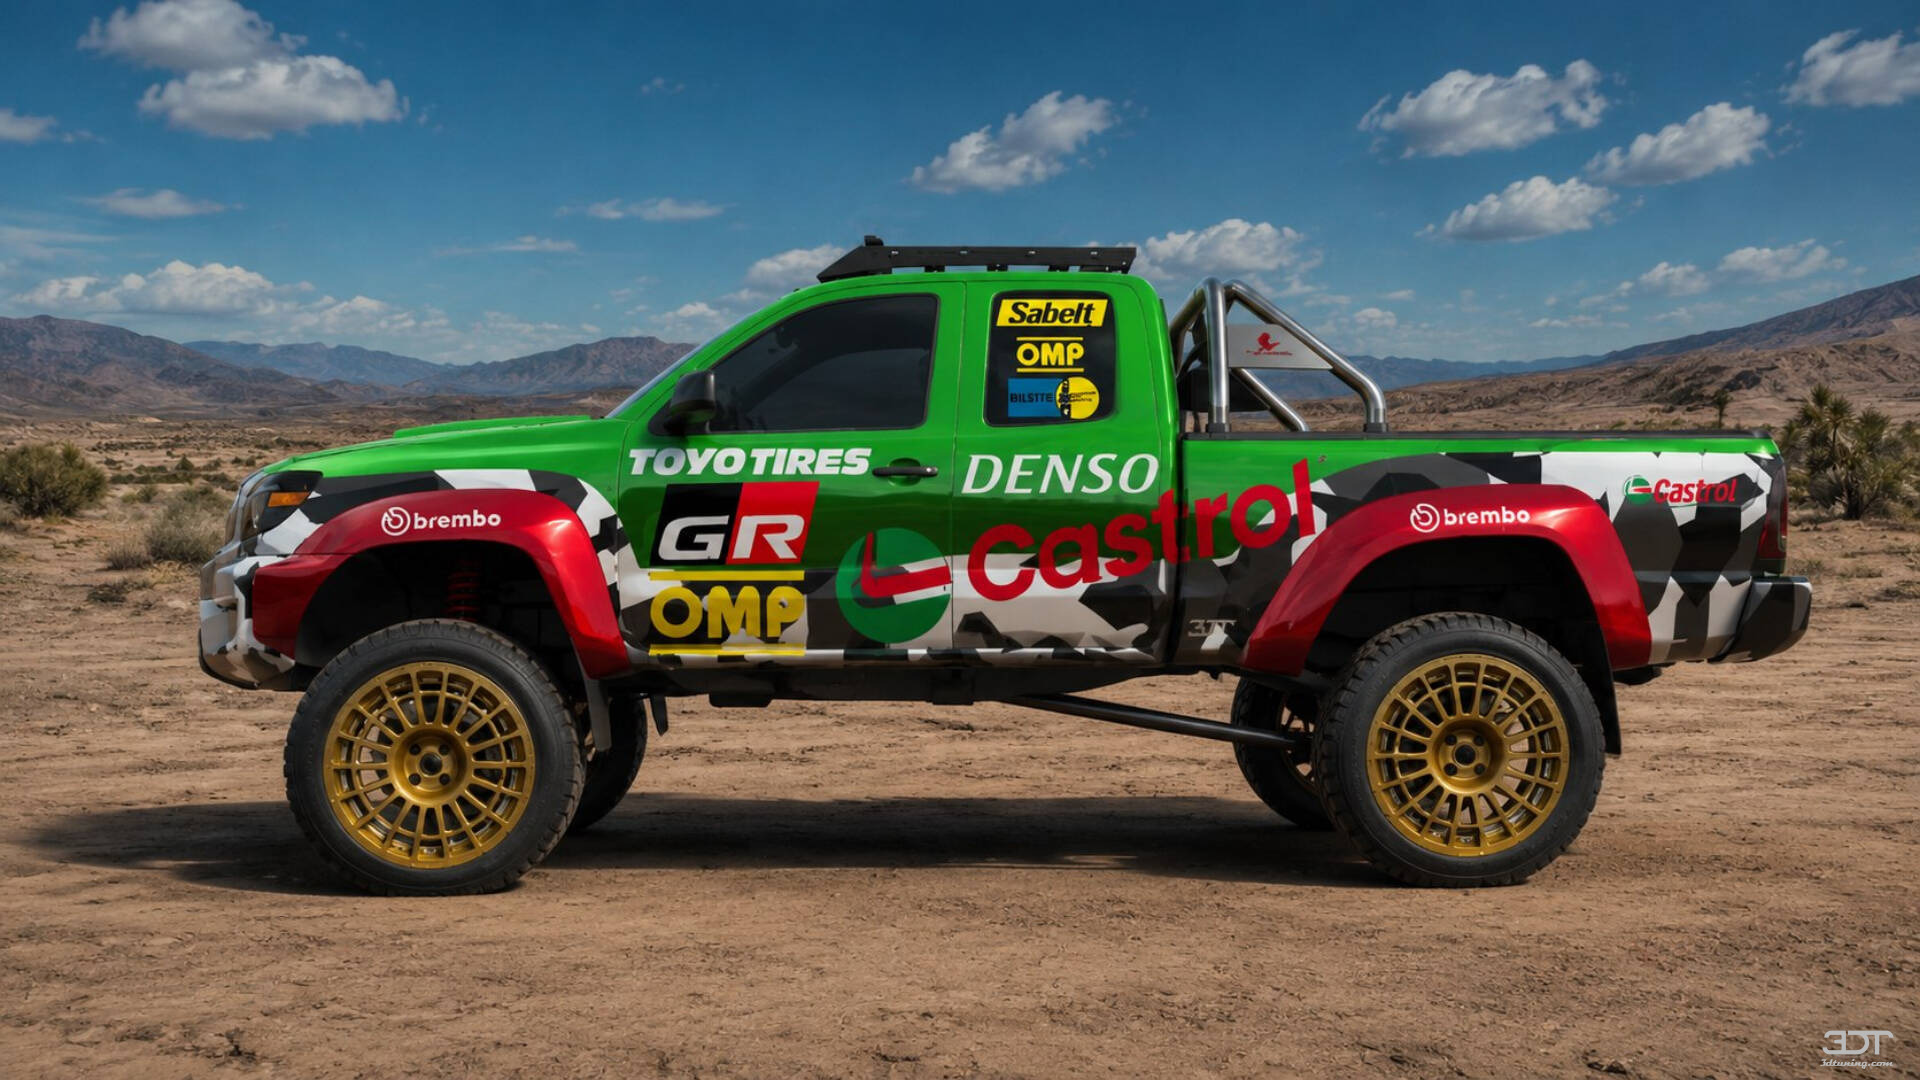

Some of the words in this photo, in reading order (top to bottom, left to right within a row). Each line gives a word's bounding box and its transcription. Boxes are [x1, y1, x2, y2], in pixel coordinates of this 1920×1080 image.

[1008, 302, 1096, 324] Sabelt
[1016, 342, 1084, 366] OMP
[961, 453, 1160, 494] DENSO
[1653, 478, 1737, 504] Castrol
[413, 509, 501, 529] brembo
[1443, 506, 1530, 526] brembo
[658, 514, 805, 560] GR
[967, 458, 1316, 601] Castrol
[650, 585, 806, 638] OMP
